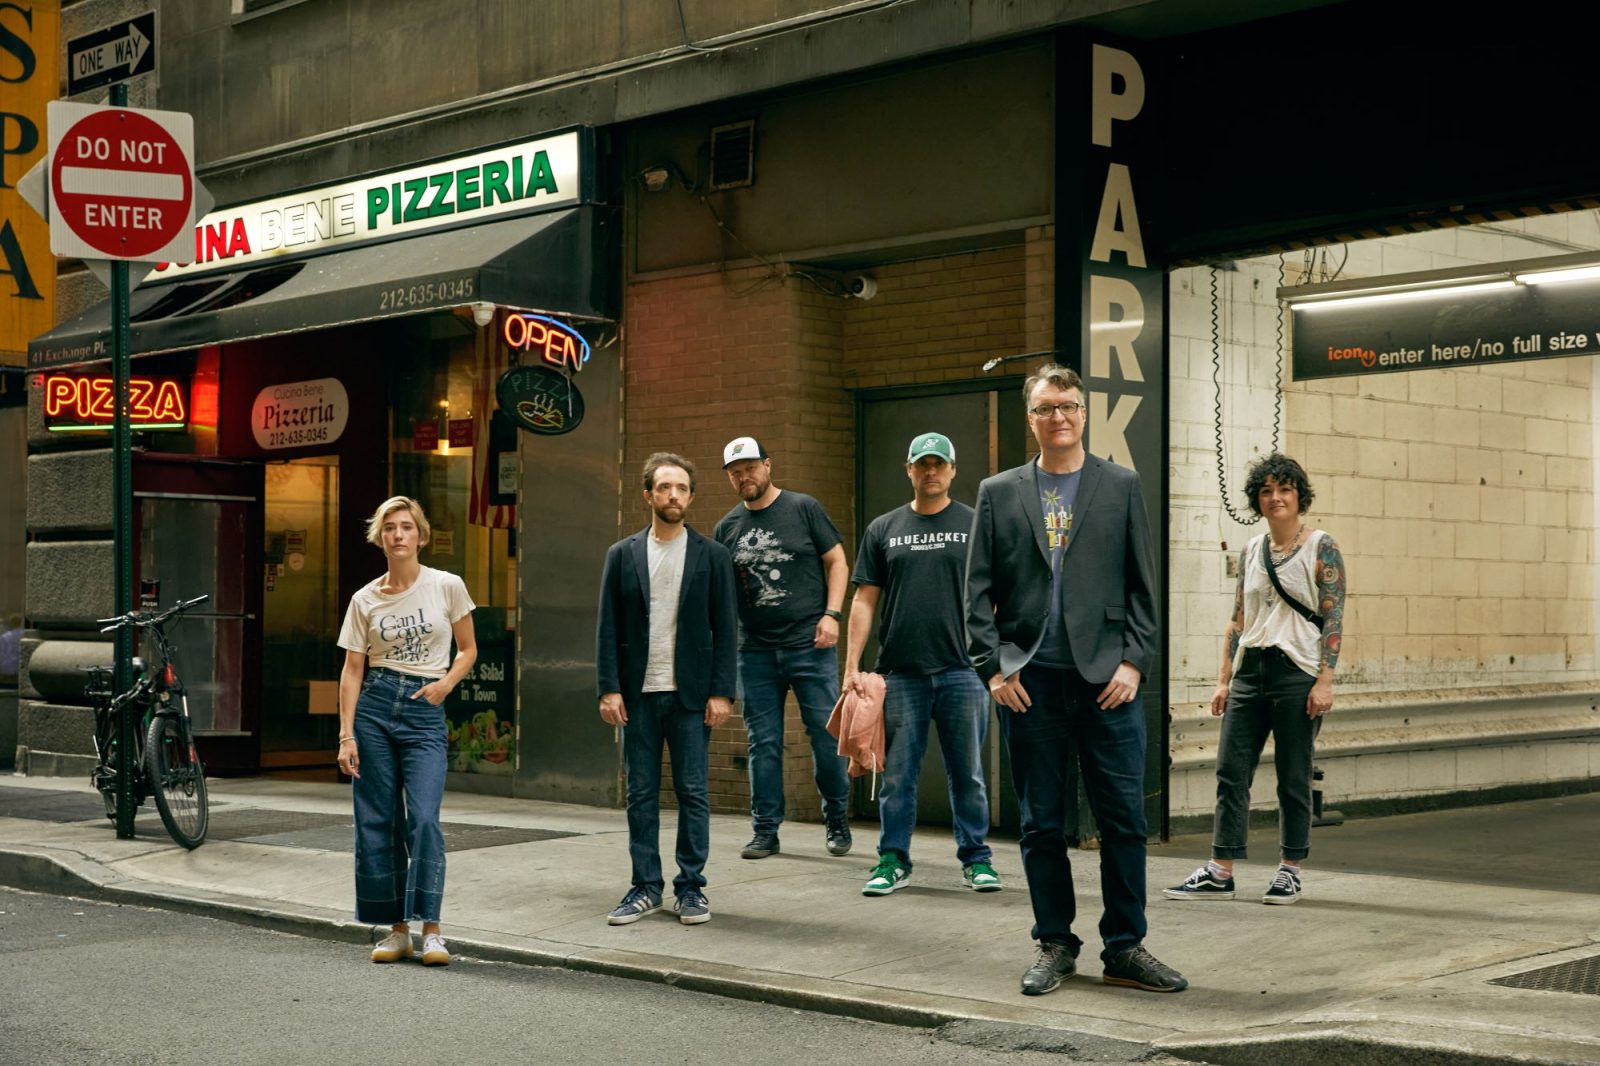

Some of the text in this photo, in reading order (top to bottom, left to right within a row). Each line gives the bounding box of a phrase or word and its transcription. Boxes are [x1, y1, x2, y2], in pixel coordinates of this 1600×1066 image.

[79, 35, 142, 76] ONE WAY
[76, 136, 167, 165] DO NOT
[261, 193, 355, 252] BENE
[367, 150, 559, 230] PIZZERIA
[85, 203, 163, 230] ENTER
[1089, 43, 1147, 471] PARK
[380, 278, 473, 310] 212-635-0345
[32, 341, 106, 364] 41 Exchange Pl.
[504, 314, 584, 372] OPEN
[1328, 346, 1362, 361] icon
[1379, 348, 1425, 366] enter
[1432, 338, 1505, 361] here/no
[1512, 334, 1541, 354] full
[1549, 331, 1588, 351] size
[46, 377, 185, 421] PIZZA
[304, 384, 324, 397] Bene
[512, 371, 574, 402] PIZZ
[263, 398, 335, 430] Pizzeria
[270, 427, 328, 446] 212-635-0345
[889, 532, 968, 548] BLUEJACKET
[380, 608, 425, 630] Can I
[480, 662, 505, 681] Salad
[460, 682, 497, 702] in Town
